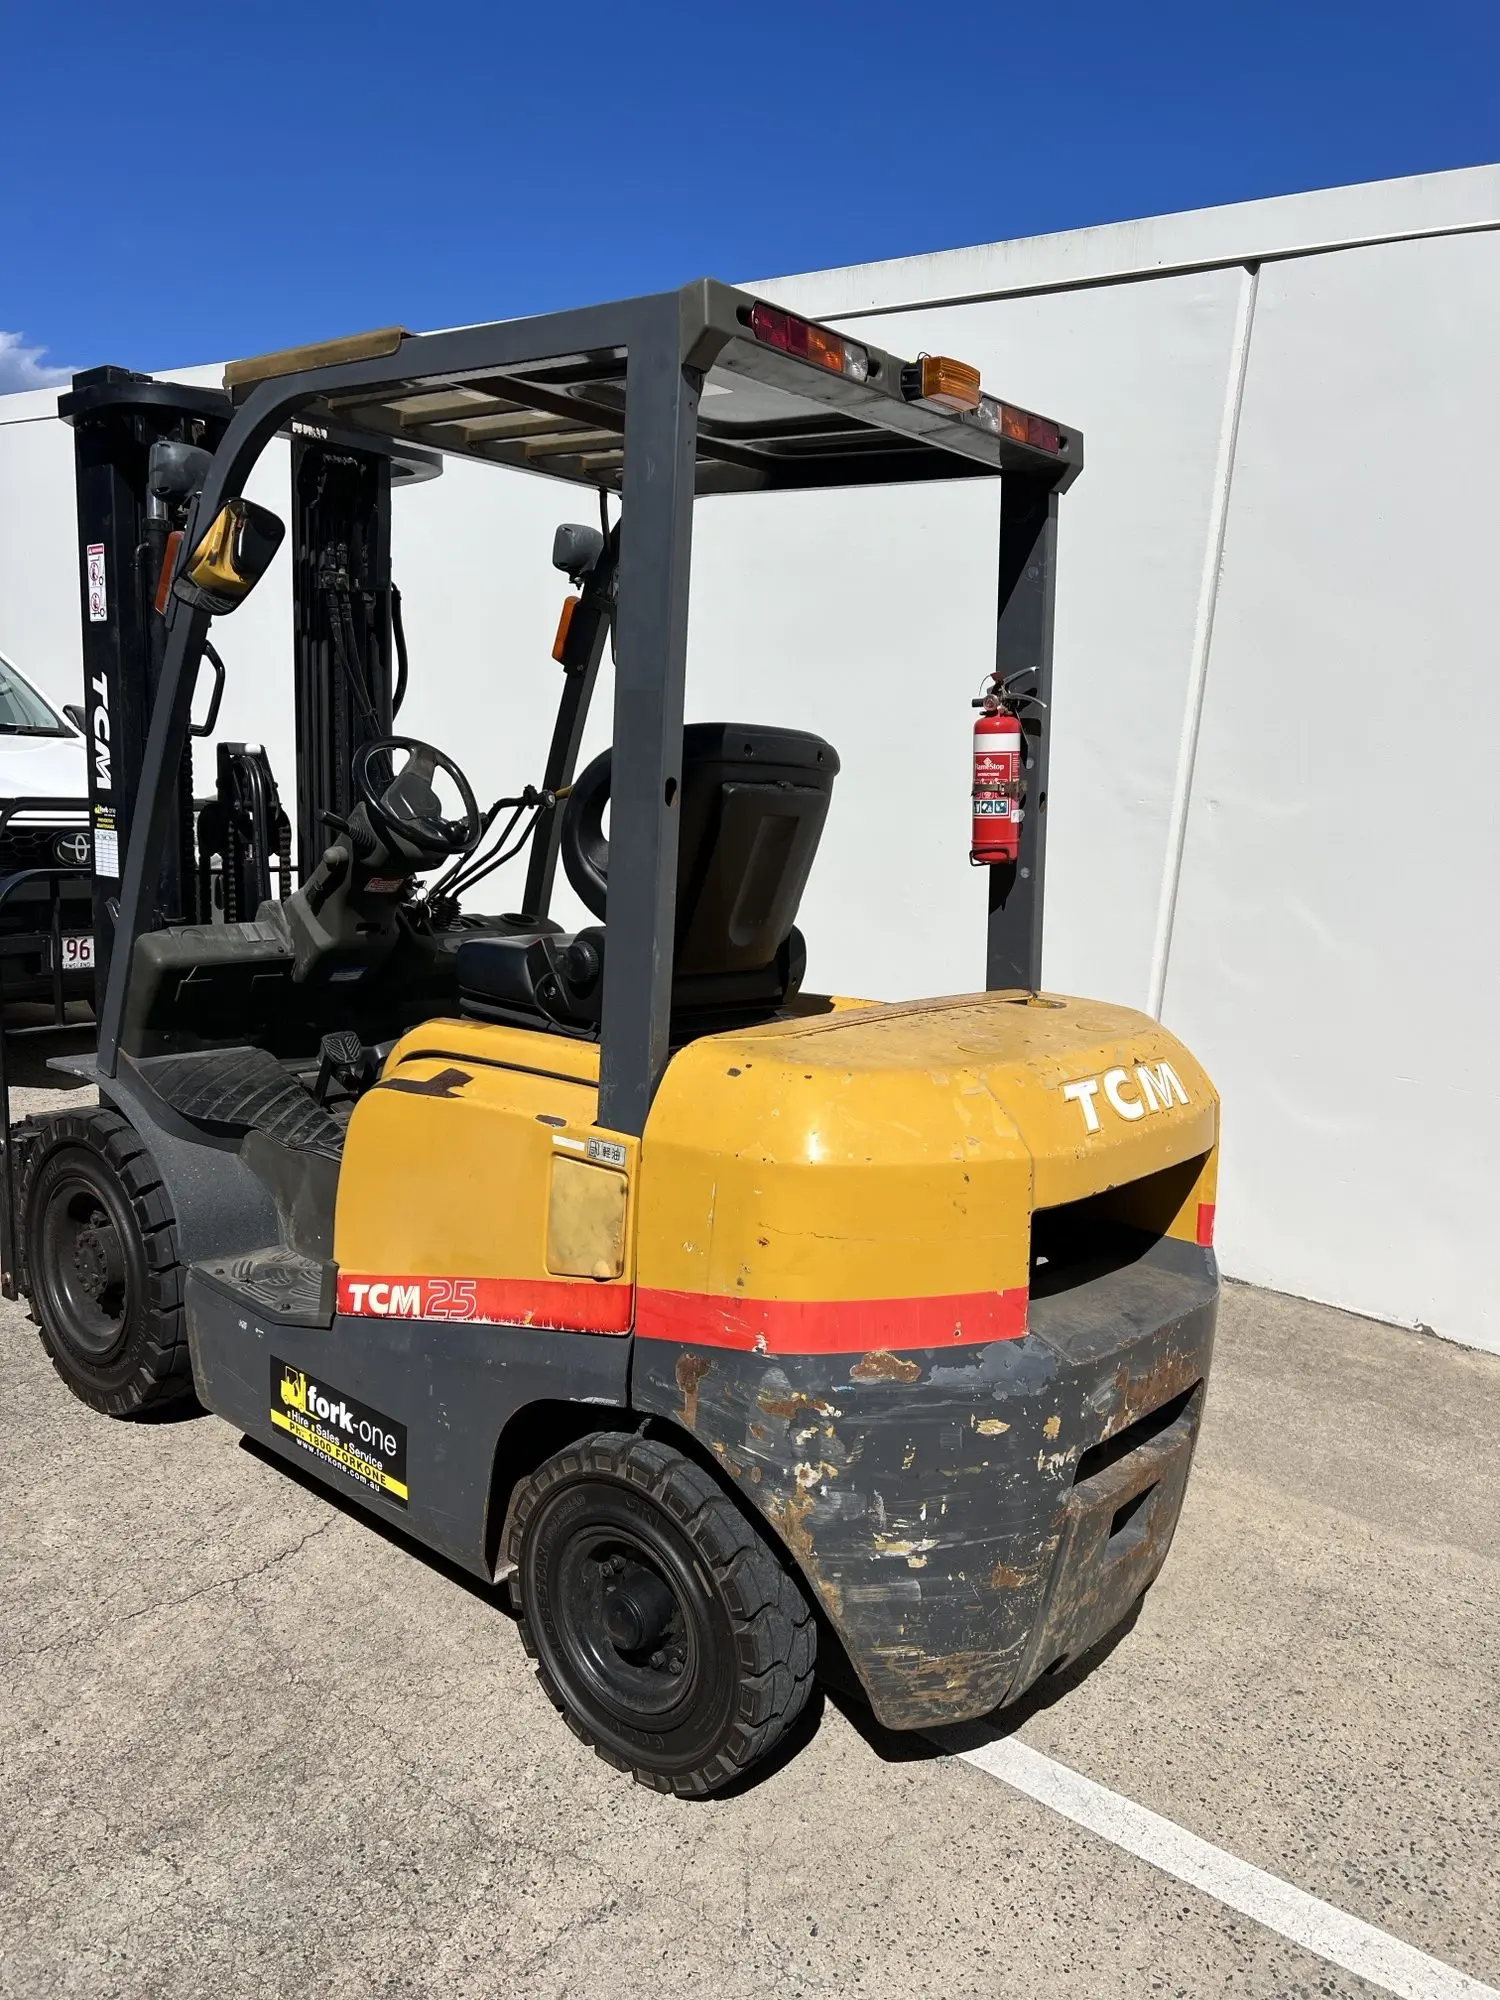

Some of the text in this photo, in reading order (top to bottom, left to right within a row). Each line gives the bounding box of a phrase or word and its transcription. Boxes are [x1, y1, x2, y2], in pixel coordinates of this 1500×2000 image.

[92, 672, 112, 790] TCM
[67, 939, 90, 961] 96
[1063, 1061, 1190, 1131] TCM
[348, 1280, 477, 1319] TCM 25
[291, 1409, 383, 1471] Hire Sales Service
[307, 1385, 397, 1456] fork-one
[296, 1437, 380, 1493] www.forkone.com.au
[309, 1433, 332, 1453] 1800
[335, 1449, 387, 1486] FORKONE
